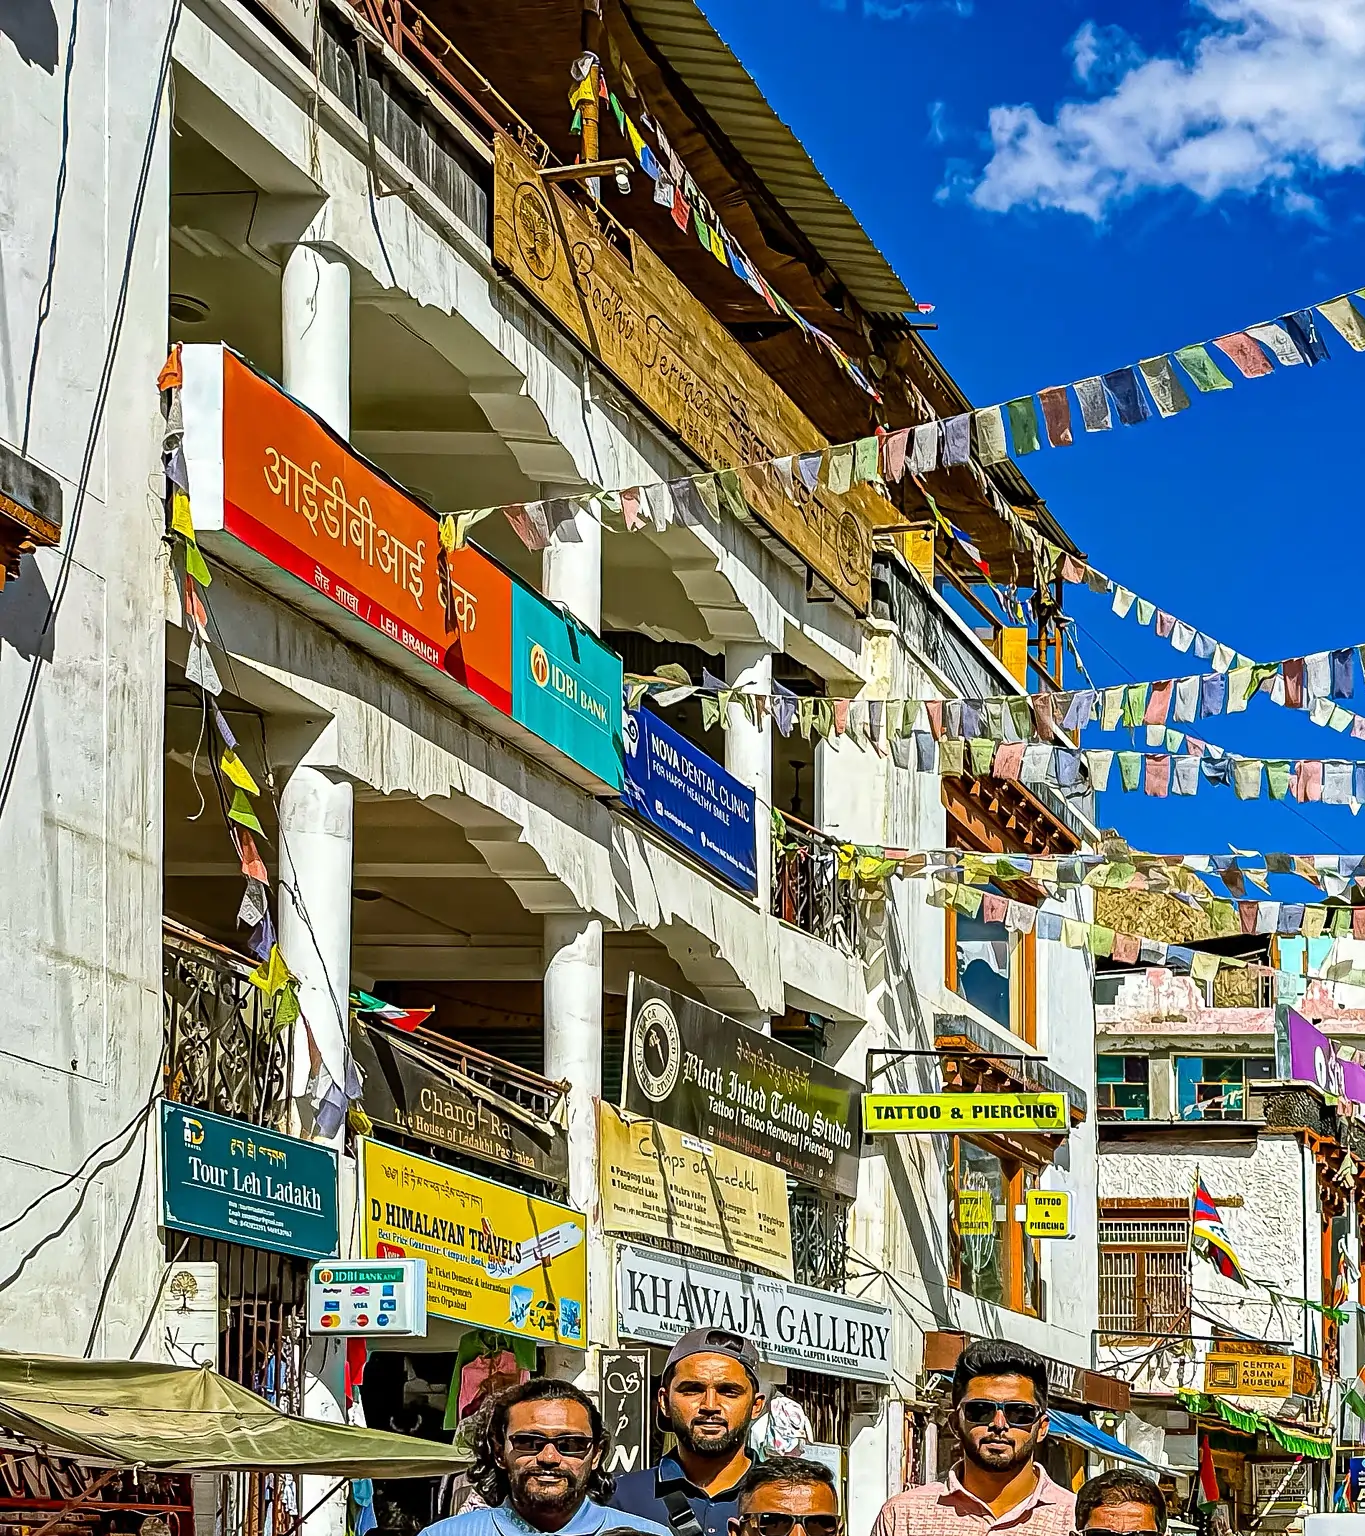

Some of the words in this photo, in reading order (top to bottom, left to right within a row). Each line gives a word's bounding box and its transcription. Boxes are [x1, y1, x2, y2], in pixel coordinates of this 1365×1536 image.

[263, 447, 426, 610] आईडीबीआई
[380, 614, 398, 638] LEH
[402, 628, 439, 665] BRANCH
[551, 663, 578, 701] IDBI
[581, 689, 609, 725] BANK
[651, 732, 680, 773] NOVA
[681, 755, 717, 799] DENTAL
[719, 784, 750, 823] CLINIC
[652, 759, 666, 779] FOR
[666, 767, 685, 792] HAPPY
[686, 781, 711, 812] HEALTHY
[712, 804, 730, 827] SMILE
[682, 1051, 723, 1095] Black
[728, 1070, 767, 1113] Inked
[770, 1090, 810, 1132] Tattoo
[811, 1110, 851, 1149] Studio
[873, 1105, 941, 1119] TATTOO
[950, 1107, 964, 1119] &
[972, 1104, 1058, 1119] PIERCING
[415, 1115, 445, 1138] House
[447, 1127, 457, 1143] of
[458, 1129, 493, 1155] Ladakhi
[495, 1142, 535, 1168] Pasmina
[708, 1095, 734, 1120] Tattoo
[740, 1110, 765, 1132] Tattoo
[766, 1124, 799, 1146] Removal
[804, 1135, 834, 1163] Piercing
[188, 1155, 229, 1188] Tour
[232, 1166, 262, 1197] Leh
[265, 1175, 322, 1211] Ladakh
[639, 1137, 686, 1176] Camps
[714, 1160, 759, 1195] Ladakh
[1030, 1221, 1065, 1230] PIERCING
[1034, 1197, 1061, 1206] TATTOO
[1044, 1210, 1050, 1218] &
[371, 1198, 381, 1222] D
[385, 1203, 465, 1247] HIMALAYAN
[468, 1228, 522, 1264] TRAVELS
[378, 1228, 391, 1240] Best
[392, 1232, 408, 1245] Price
[335, 1271, 358, 1281] IDBI
[359, 1272, 384, 1281] BANK
[434, 1266, 451, 1280] Ticket
[627, 1268, 769, 1343] KHAWAJA
[776, 1304, 890, 1361] GALLERY
[1242, 1360, 1287, 1370] CENTRAL
[1242, 1369, 1273, 1378] ASIAN
[1242, 1378, 1285, 1388] MUSEUM
